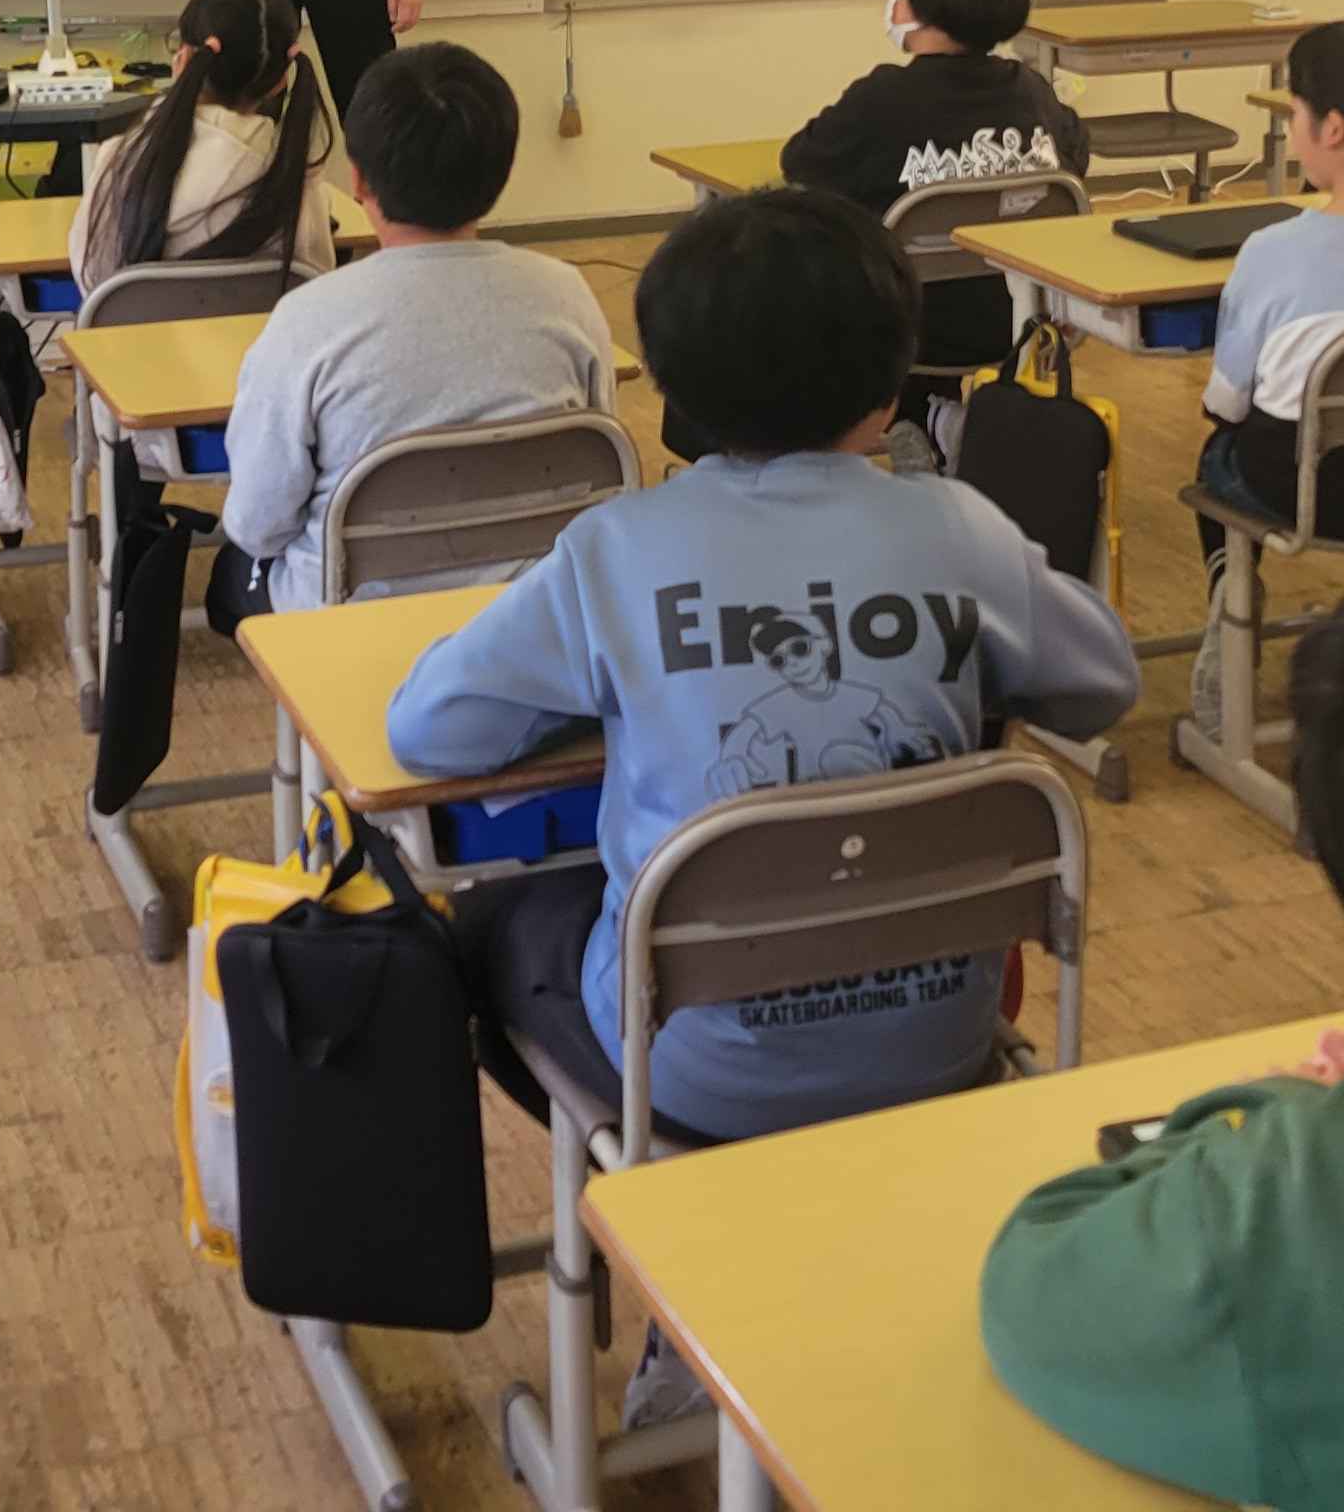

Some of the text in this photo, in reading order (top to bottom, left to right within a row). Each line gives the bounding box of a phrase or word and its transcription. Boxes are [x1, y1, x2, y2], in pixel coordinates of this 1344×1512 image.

[654, 580, 981, 684] Enjoy
[738, 984, 907, 1029] SKATEBOARDING
[917, 972, 967, 1003] TEAM
